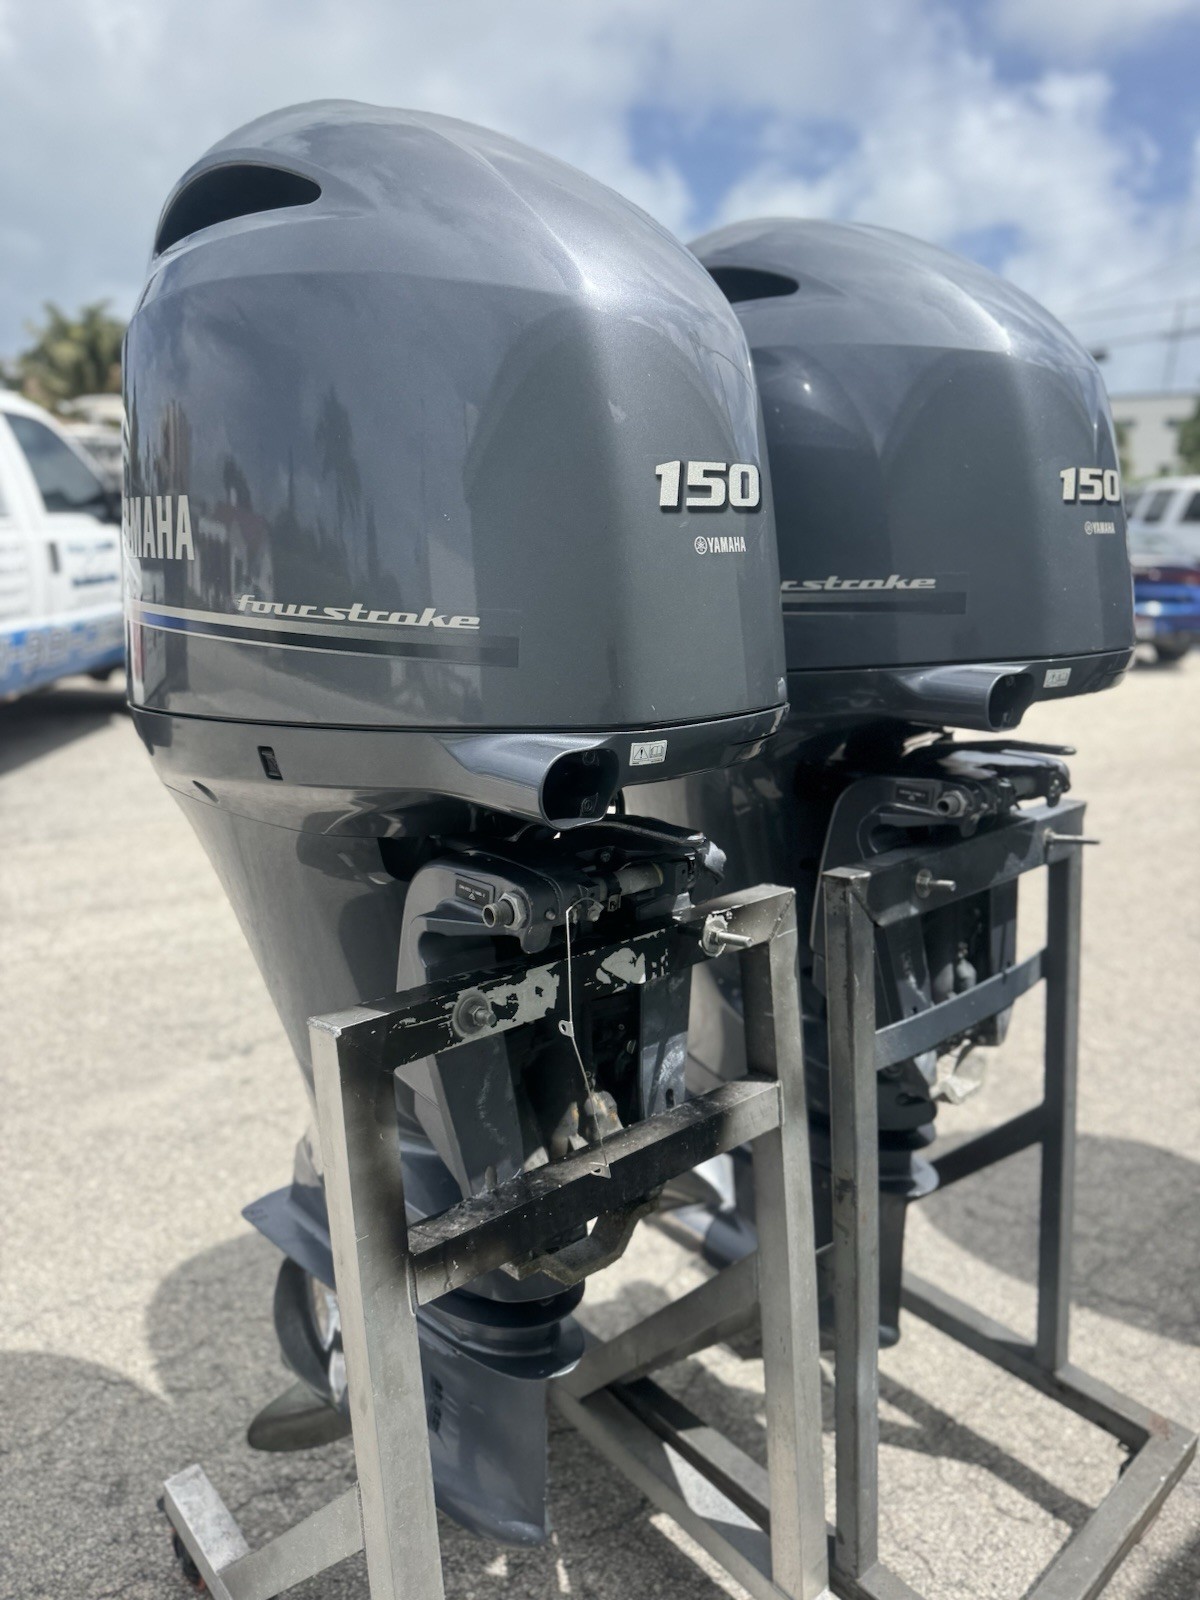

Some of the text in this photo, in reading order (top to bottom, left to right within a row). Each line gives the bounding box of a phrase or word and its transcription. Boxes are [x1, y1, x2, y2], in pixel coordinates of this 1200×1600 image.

[655, 460, 761, 510] 150
[1059, 466, 1121, 502] 150
[706, 536, 747, 554] YAMAHA
